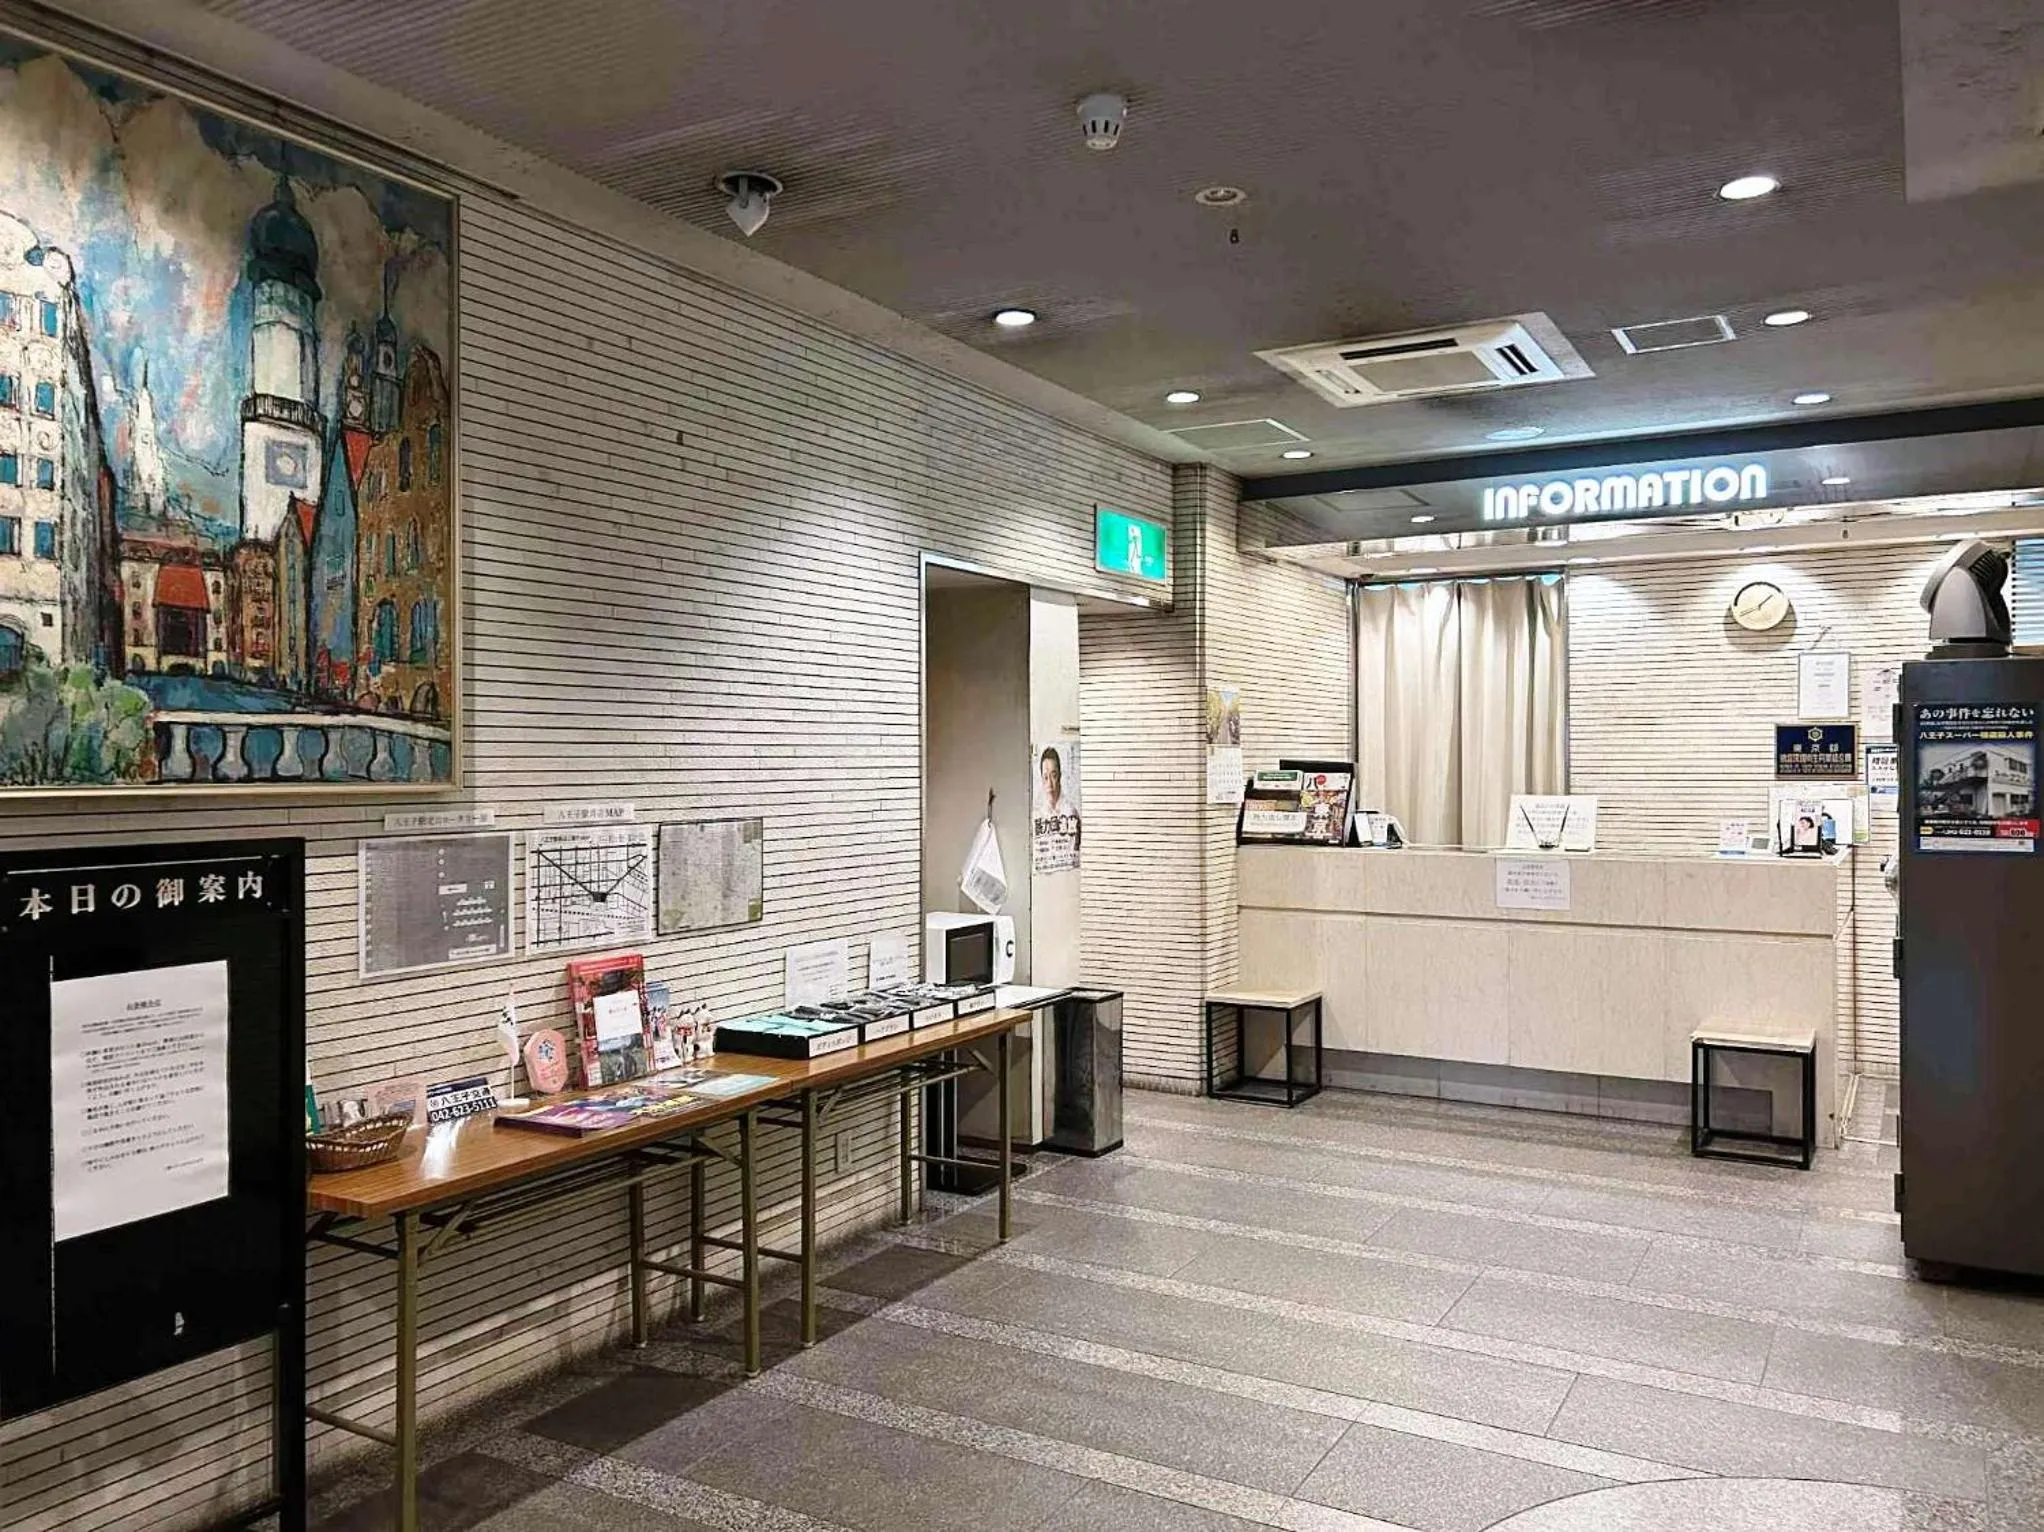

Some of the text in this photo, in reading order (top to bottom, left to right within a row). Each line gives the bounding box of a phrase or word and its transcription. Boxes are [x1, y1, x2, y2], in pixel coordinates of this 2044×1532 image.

[1483, 464, 1767, 521] INFORMATION
[1919, 707, 2035, 720] あの事件を忘れない
[18, 870, 265, 921] 本日の御案内
[440, 1086, 492, 1106] 八王子交通
[431, 1097, 498, 1122] 042-623-5111
